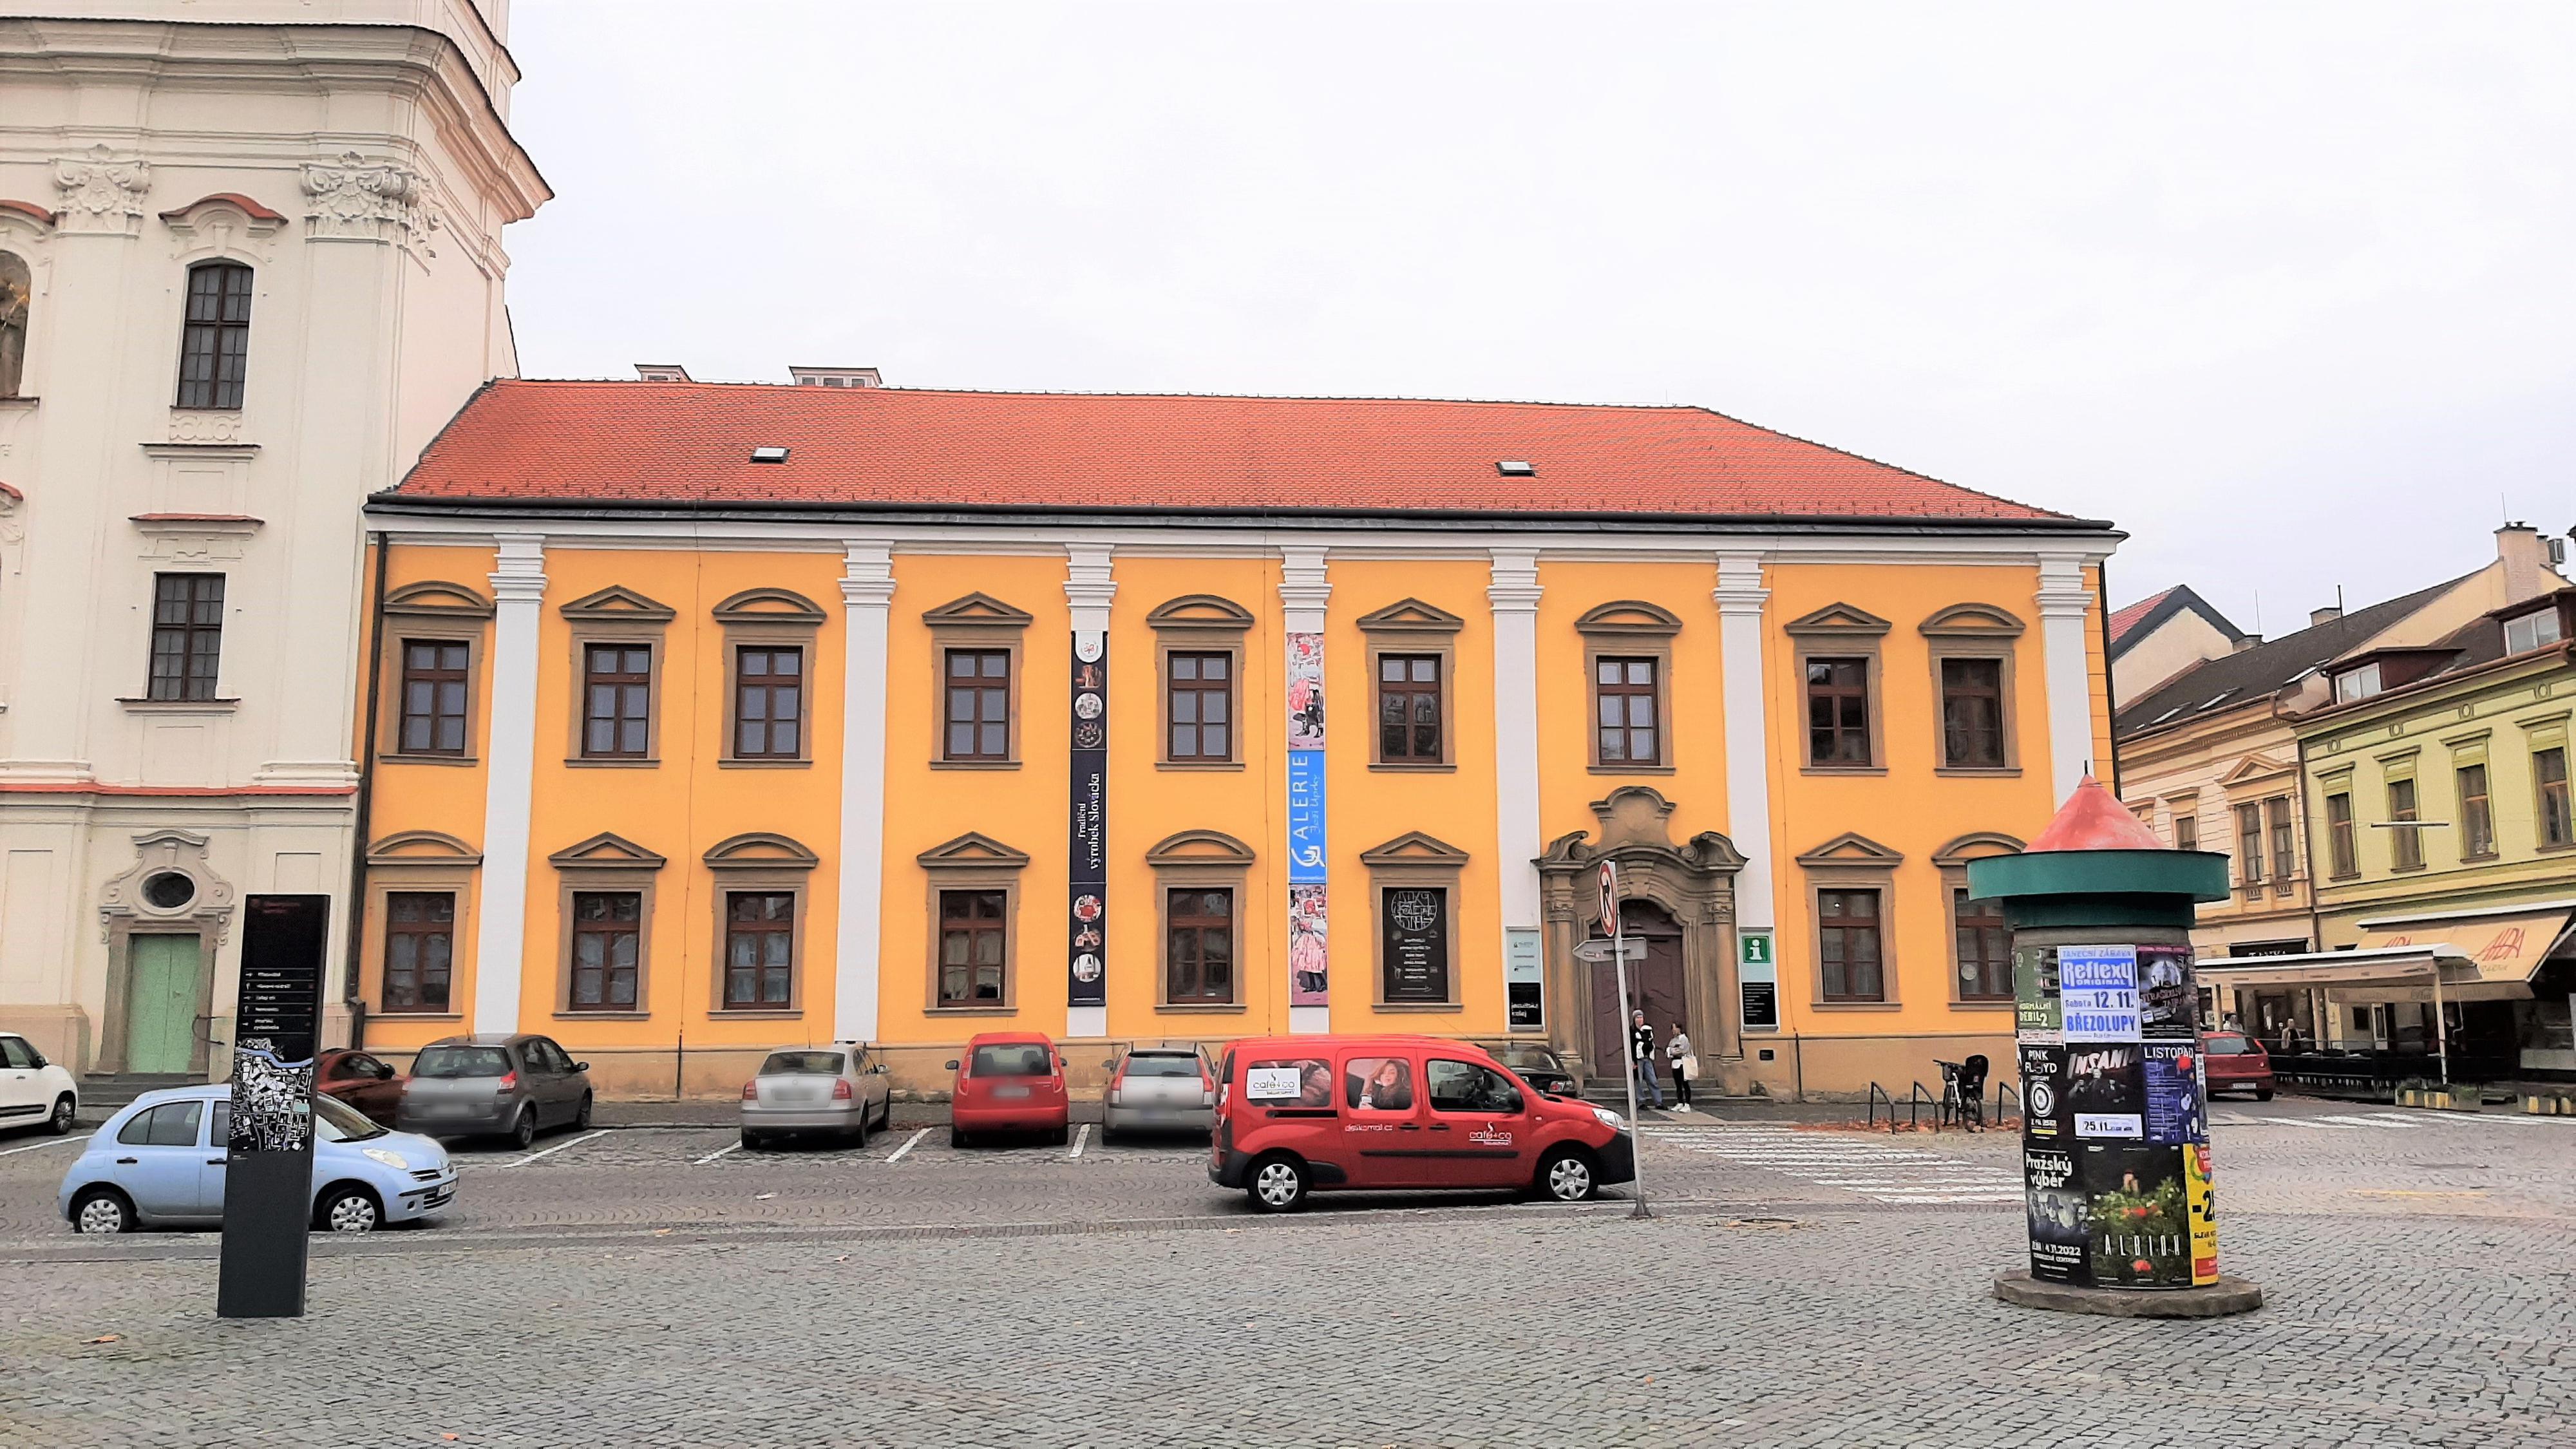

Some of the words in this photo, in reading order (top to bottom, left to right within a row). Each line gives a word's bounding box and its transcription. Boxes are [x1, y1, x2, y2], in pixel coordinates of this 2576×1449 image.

[1086, 773, 1101, 822] Slovácka
[1086, 824, 1102, 870] výrobek
[2062, 961, 2134, 987] Reflexy
[2094, 991, 2114, 1009] 12.
[2116, 991, 2134, 1009] 11.
[2066, 1012, 2136, 1032] BŘEZOLUPY
[2027, 1050, 2049, 1061] PINK
[2144, 1046, 2193, 1059] LISTOPAD
[2025, 1152, 2072, 1177] Pražský
[2030, 1170, 2065, 1191] výběr
[2105, 1234, 2181, 1257] ALBION
